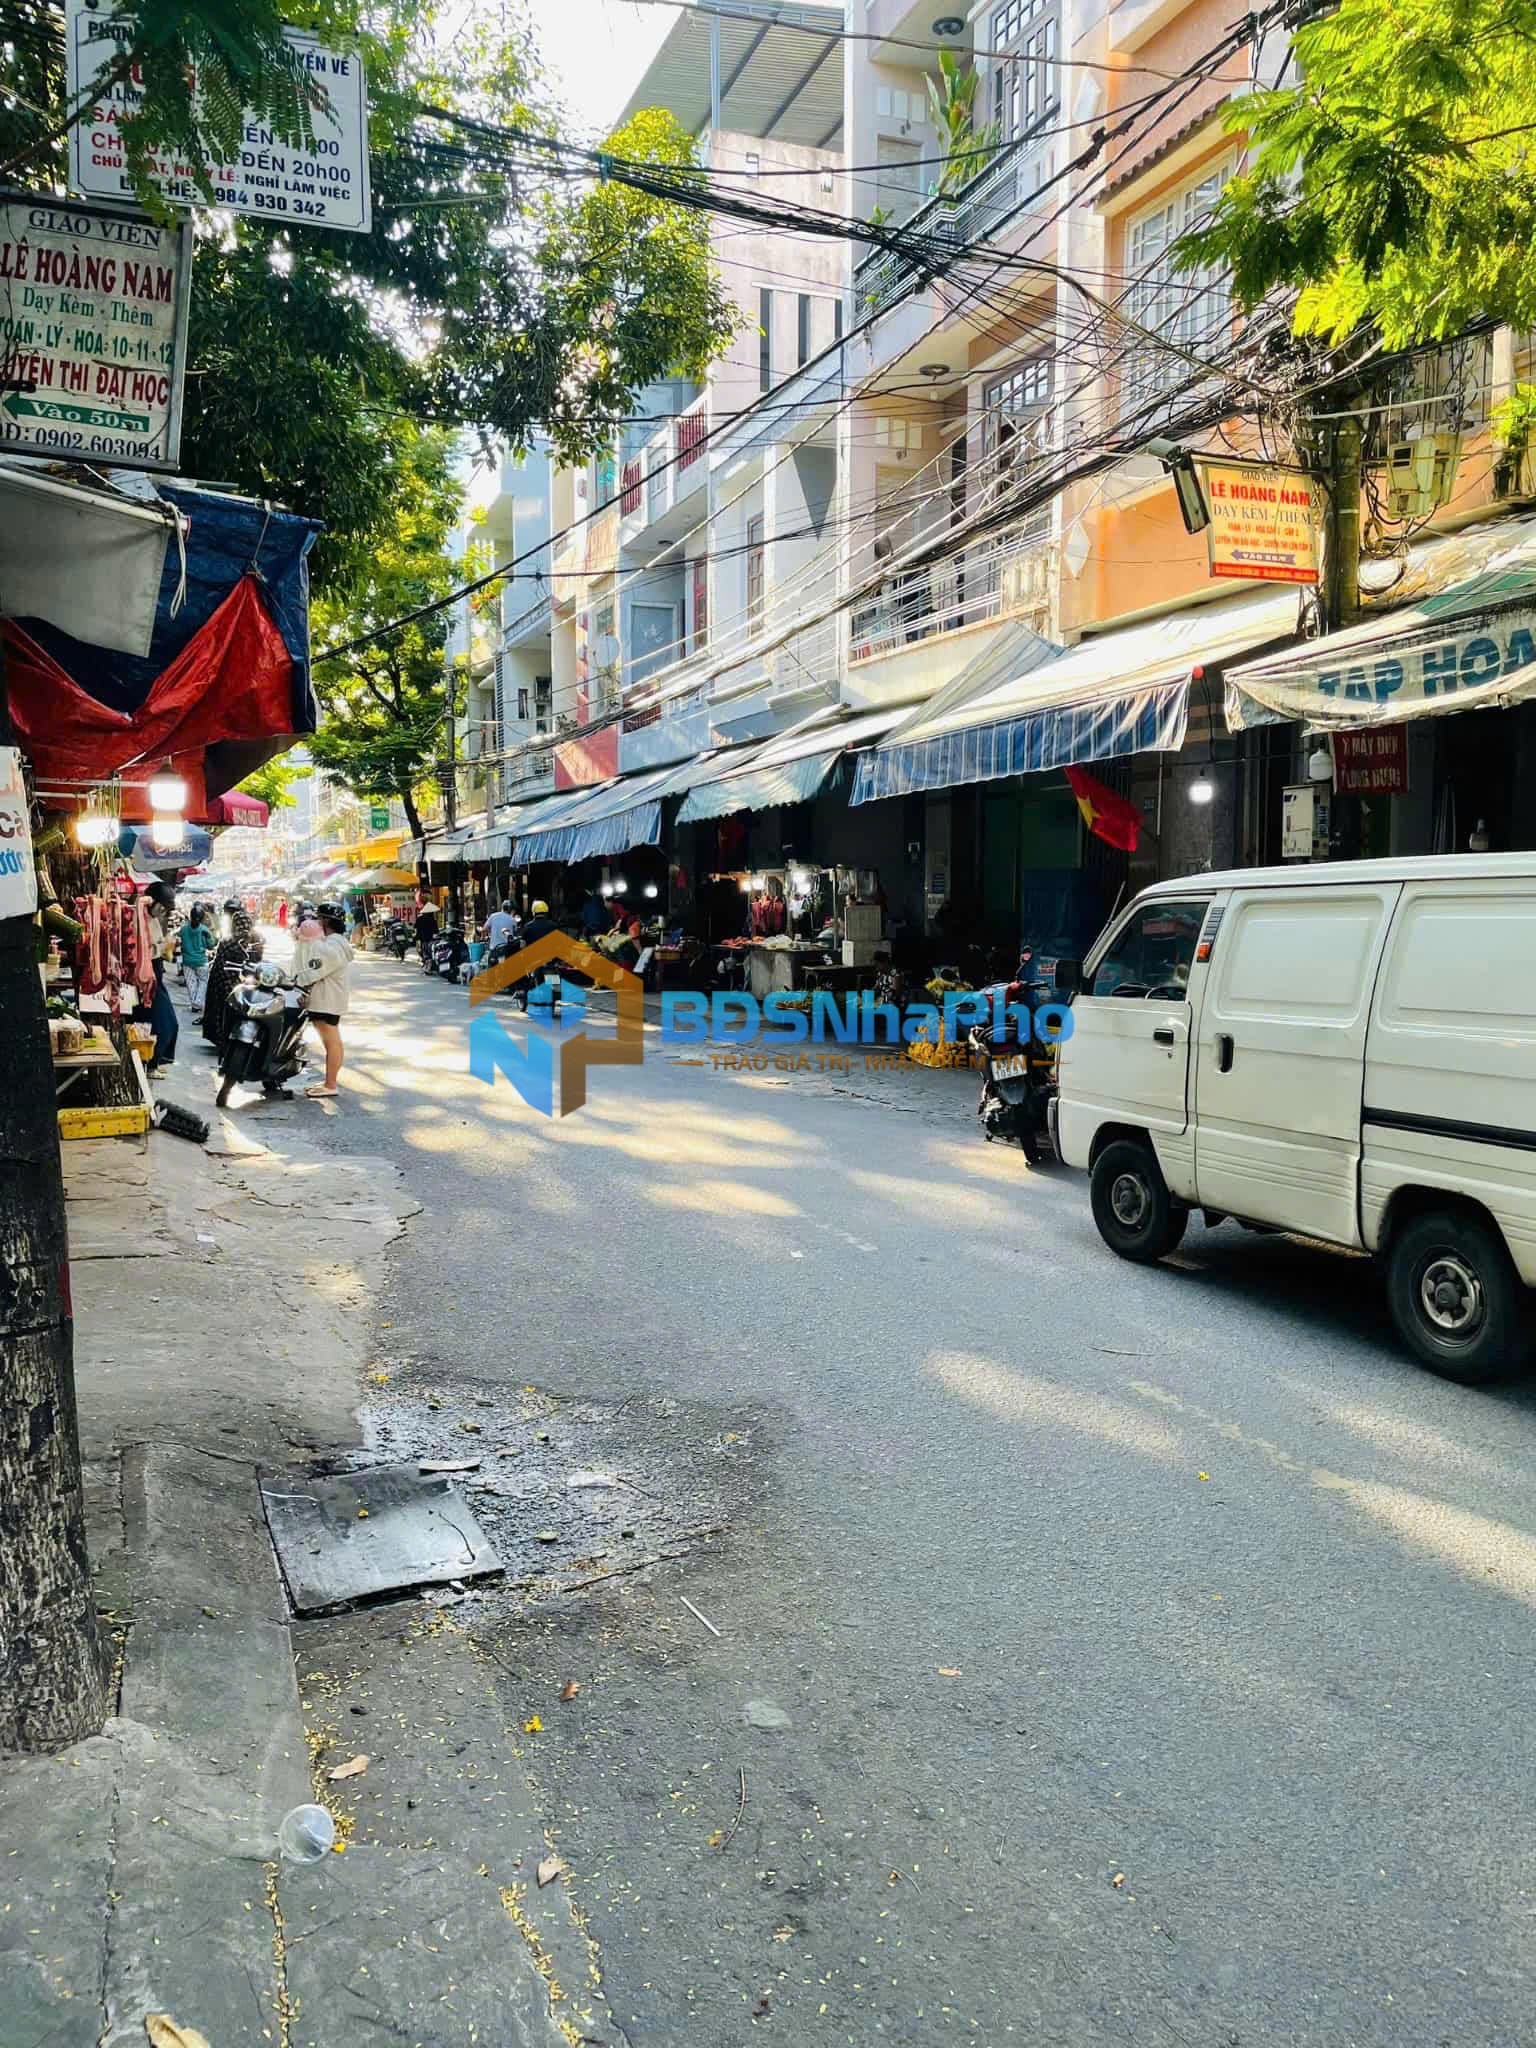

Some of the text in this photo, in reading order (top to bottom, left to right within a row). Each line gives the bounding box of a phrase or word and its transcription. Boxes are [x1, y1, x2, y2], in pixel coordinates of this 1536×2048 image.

[293, 160, 350, 183] 20h00
[254, 193, 287, 211] 930
[293, 199, 326, 217] 342
[0, 235, 173, 303] LÊ HOÀNG NAM
[22, 287, 153, 327] Dạy Kèm Thêm
[59, 360, 89, 392] THI
[132, 372, 169, 411] HỌC
[31, 401, 144, 432] Vào 50m
[1231, 483, 1277, 503] HOÀNG
[1280, 488, 1312, 507] NAM
